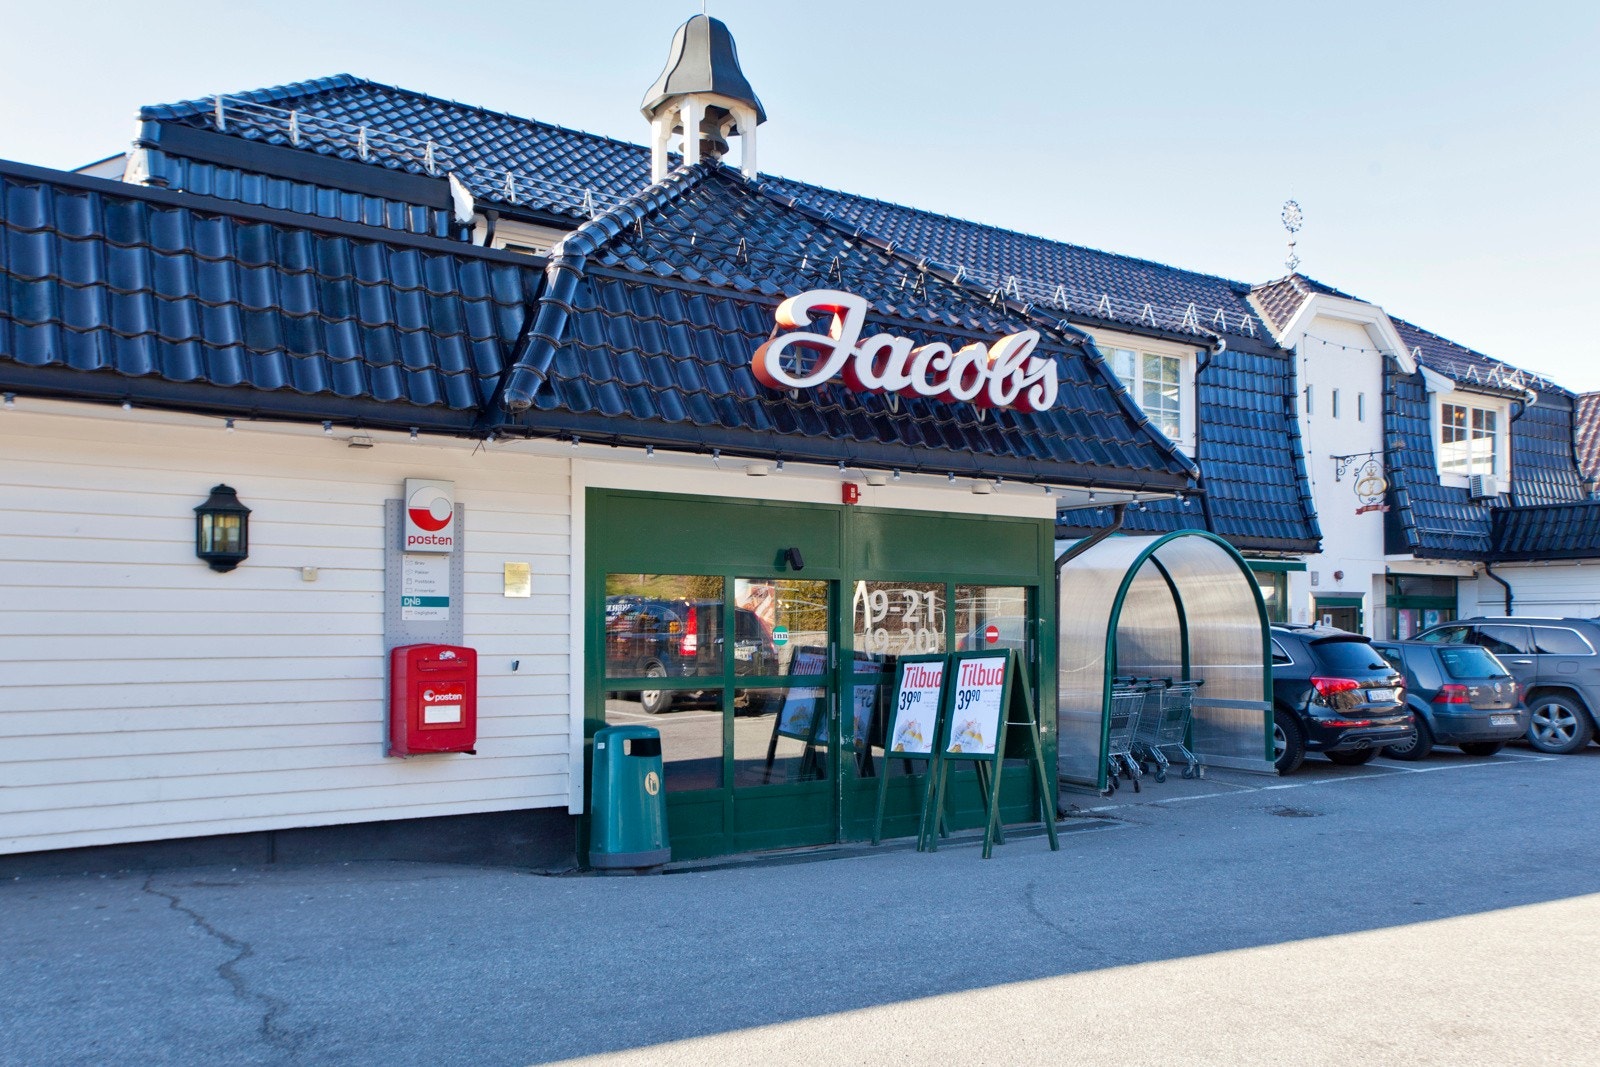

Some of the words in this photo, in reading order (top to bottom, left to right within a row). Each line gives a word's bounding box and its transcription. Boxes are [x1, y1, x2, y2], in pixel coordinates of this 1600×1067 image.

[756, 288, 1058, 412] Jacobs
[407, 533, 453, 546] posten
[403, 596, 422, 607] DNB
[869, 589, 936, 623] 9-21
[961, 662, 1006, 687] Tilbud
[434, 693, 463, 702] posten
